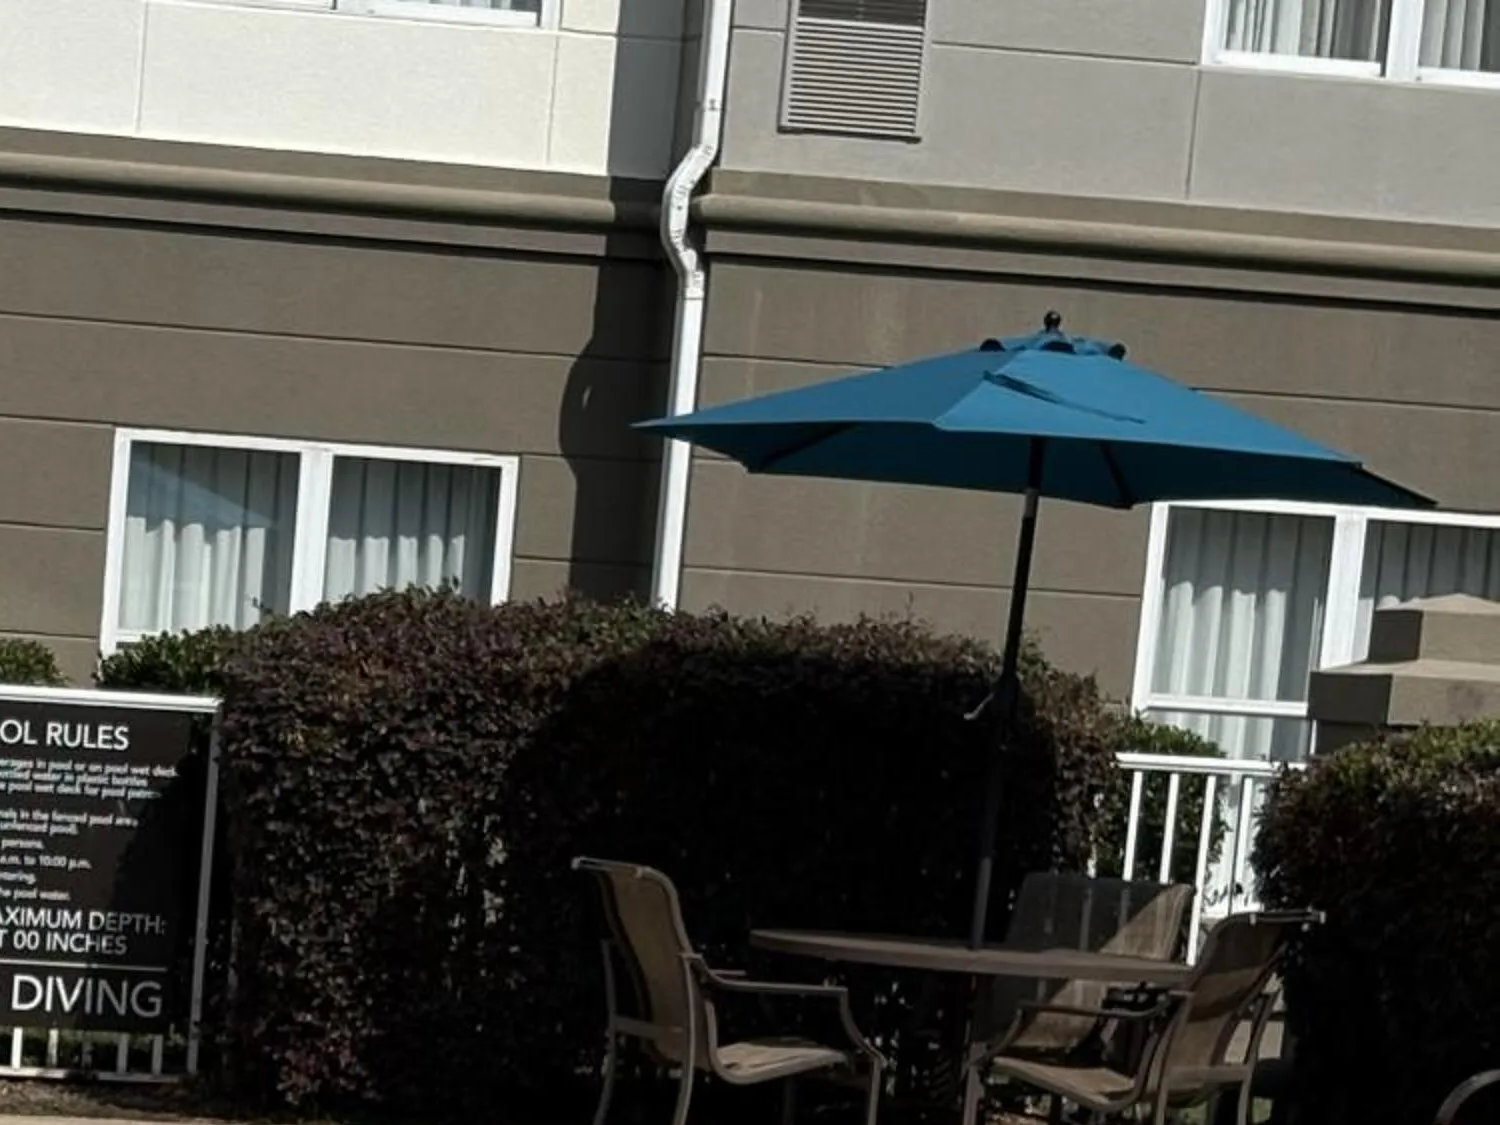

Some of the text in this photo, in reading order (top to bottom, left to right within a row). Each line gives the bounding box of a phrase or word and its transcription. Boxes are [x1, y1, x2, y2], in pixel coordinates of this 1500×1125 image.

[46, 722, 130, 751] RULES
[38, 855, 67, 867] 10:00
[13, 888, 37, 900] pool
[88, 910, 166, 936] DEPTH:
[13, 930, 40, 951] 00
[47, 932, 128, 955] INCHES
[11, 973, 163, 1018] DIVING
